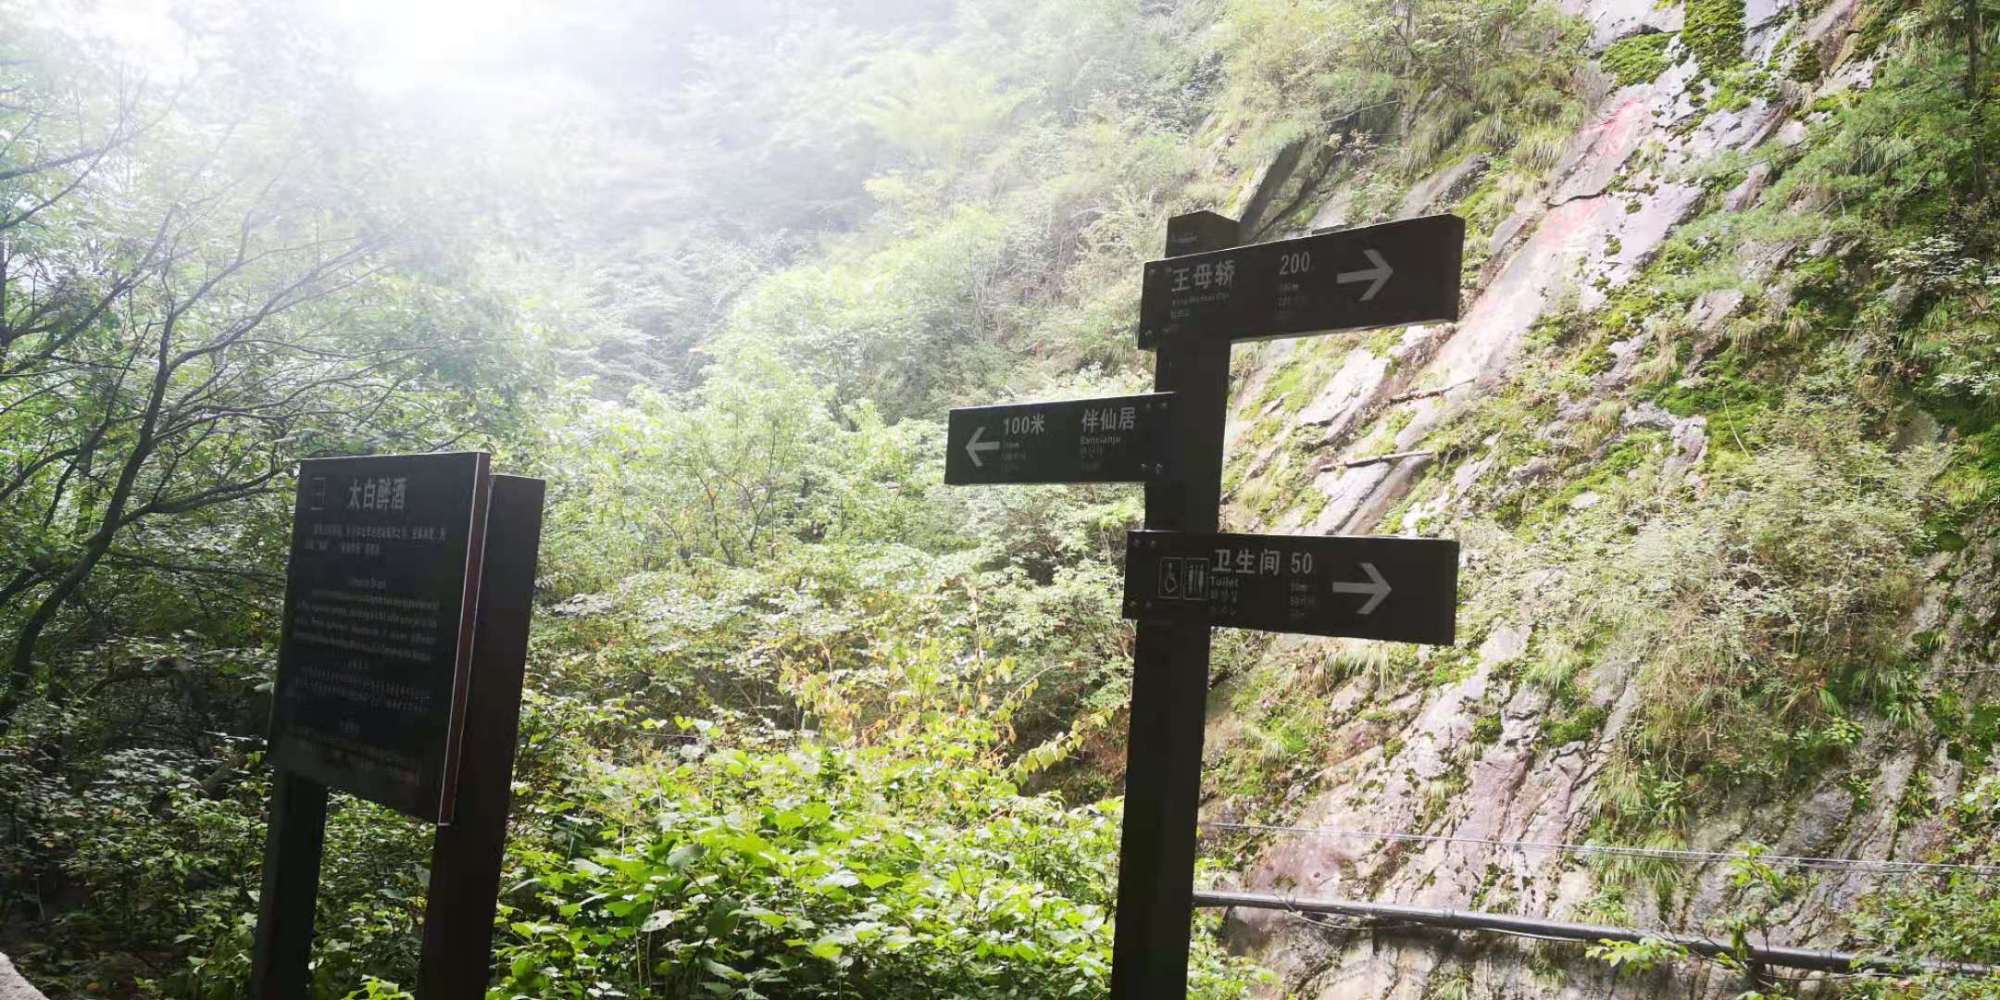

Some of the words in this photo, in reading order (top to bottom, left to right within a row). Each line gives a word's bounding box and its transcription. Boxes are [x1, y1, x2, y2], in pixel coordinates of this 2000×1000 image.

[1279, 251, 1311, 275] 200
[1003, 411, 1046, 436] 100米
[1081, 406, 1137, 433] 伴仙居
[346, 476, 408, 512] 太白醉酒
[1211, 548, 1281, 576] 卫生间
[1290, 552, 1313, 575] 50
